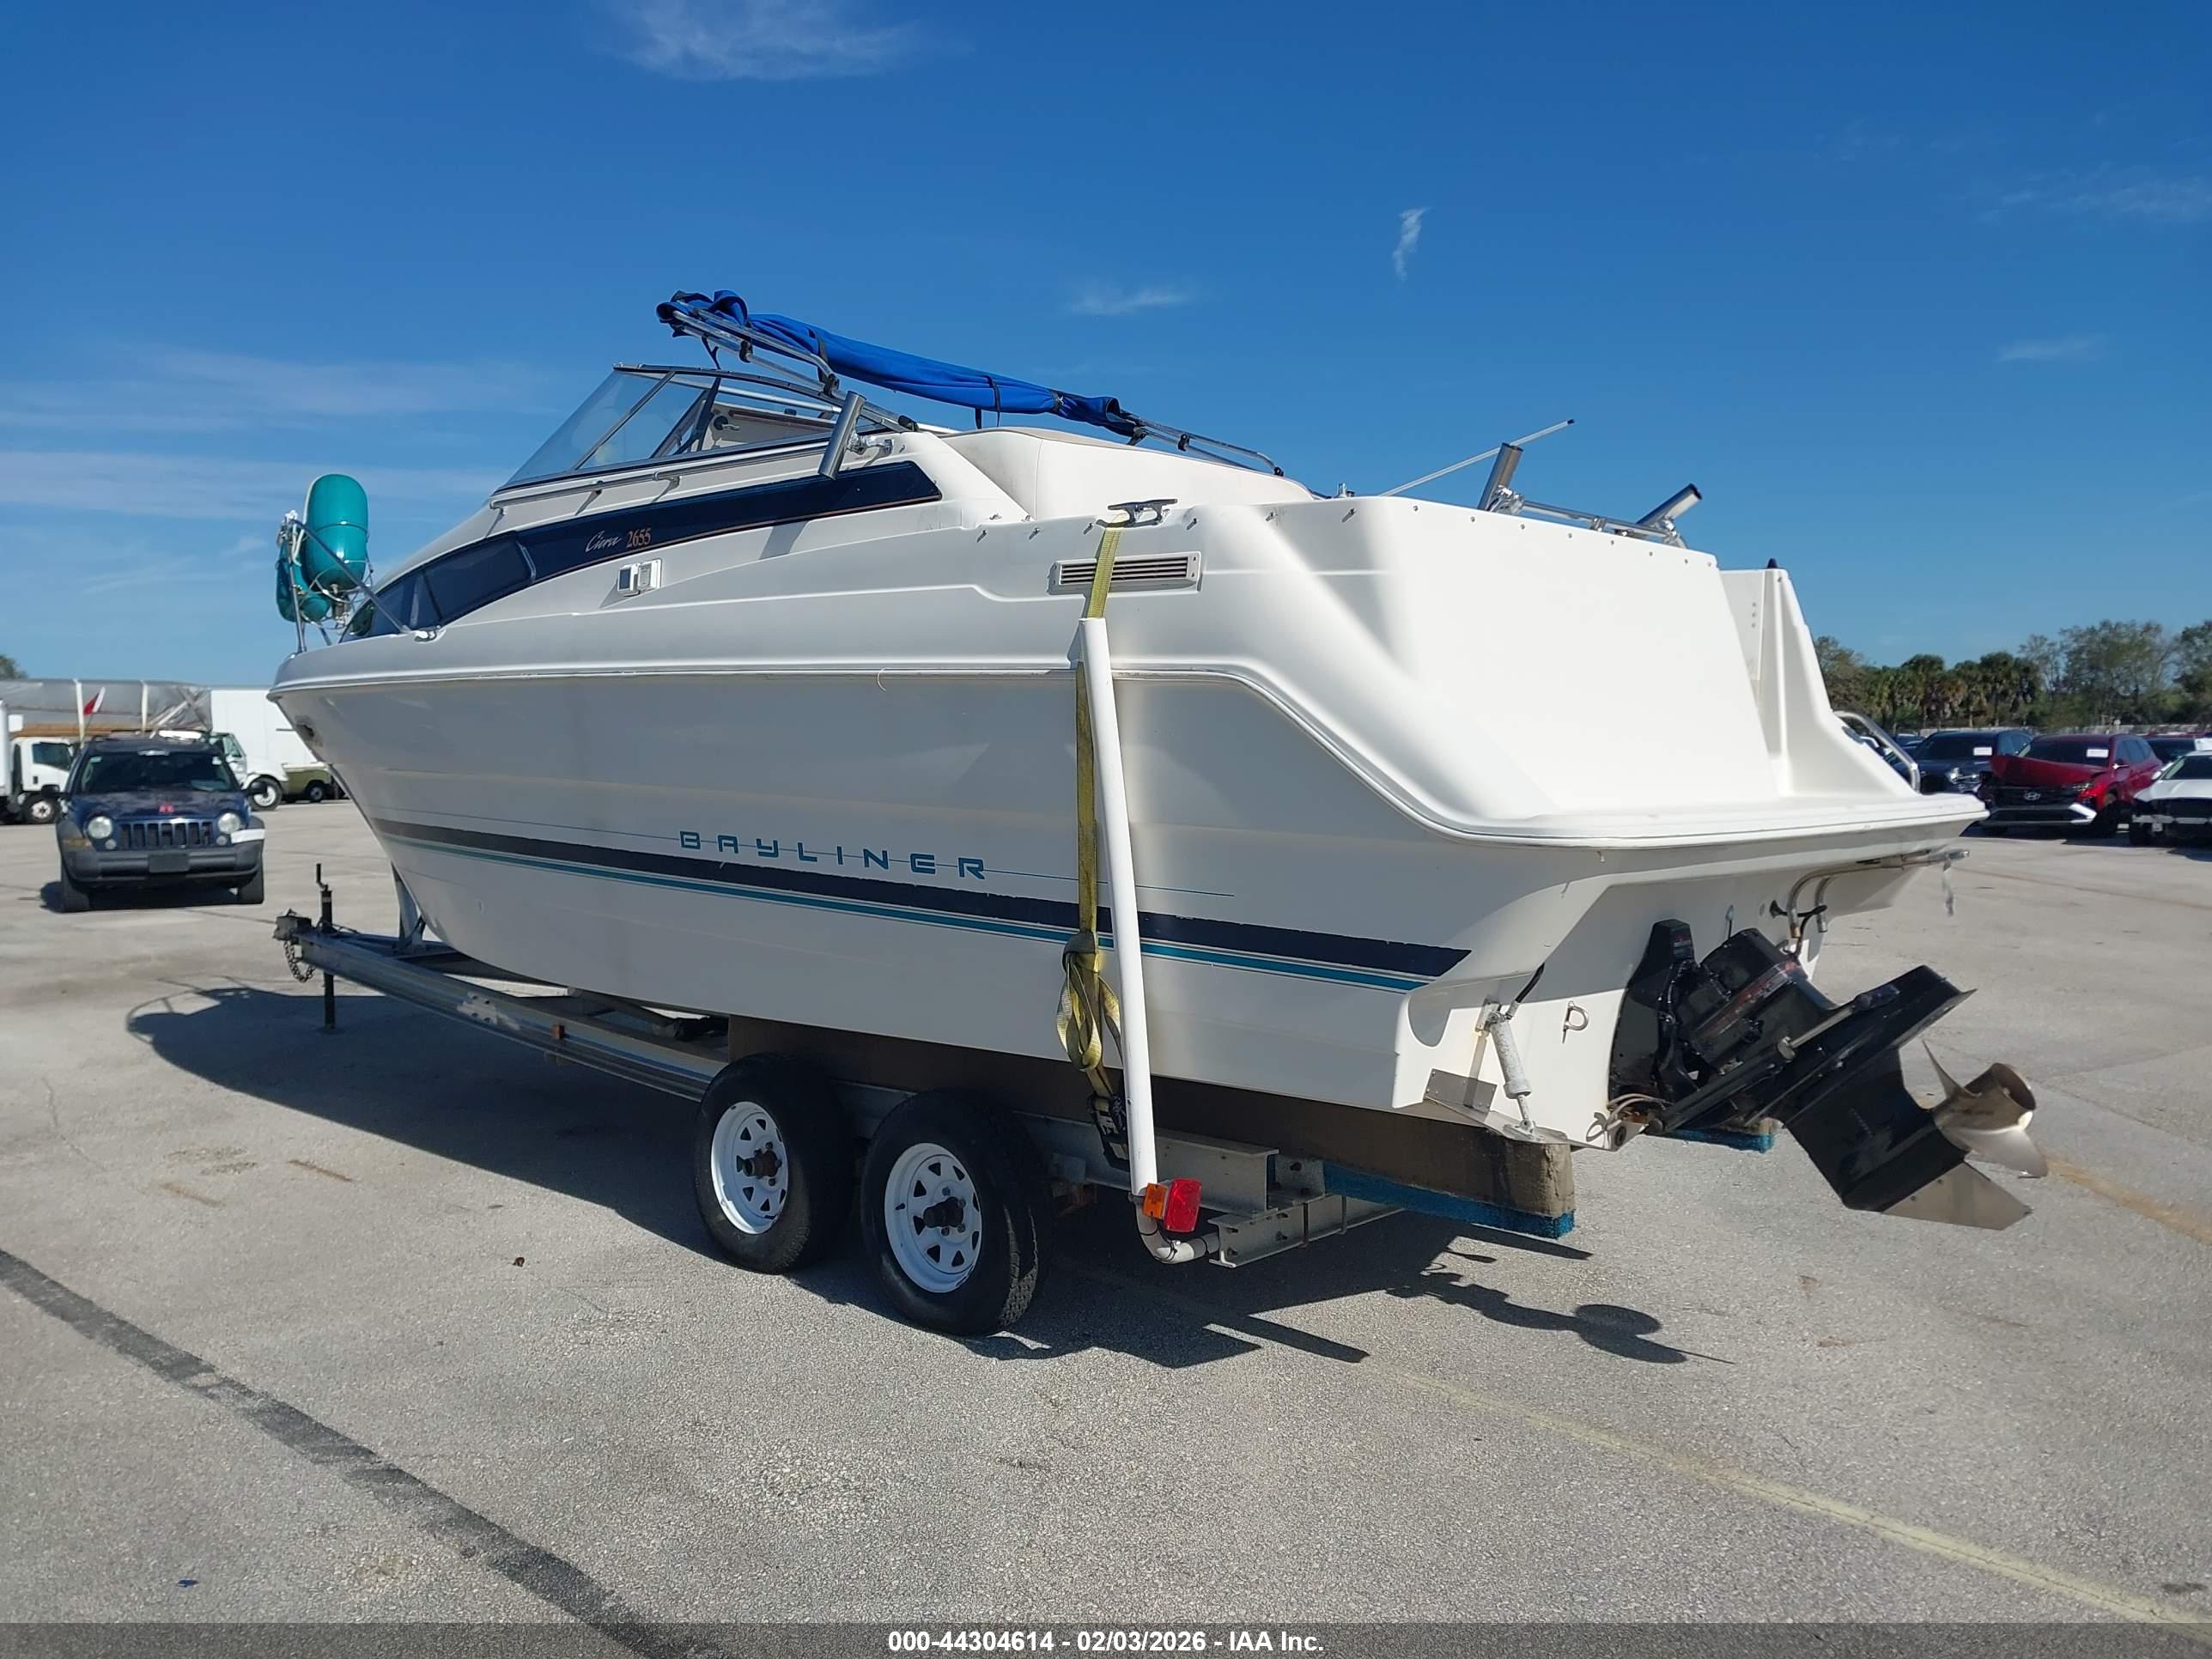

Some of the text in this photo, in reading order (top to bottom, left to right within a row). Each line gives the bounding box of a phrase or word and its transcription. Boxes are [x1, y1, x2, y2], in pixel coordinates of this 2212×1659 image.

[585, 527, 652, 553] Ciera 2655
[679, 830, 986, 880] BAYLINER
